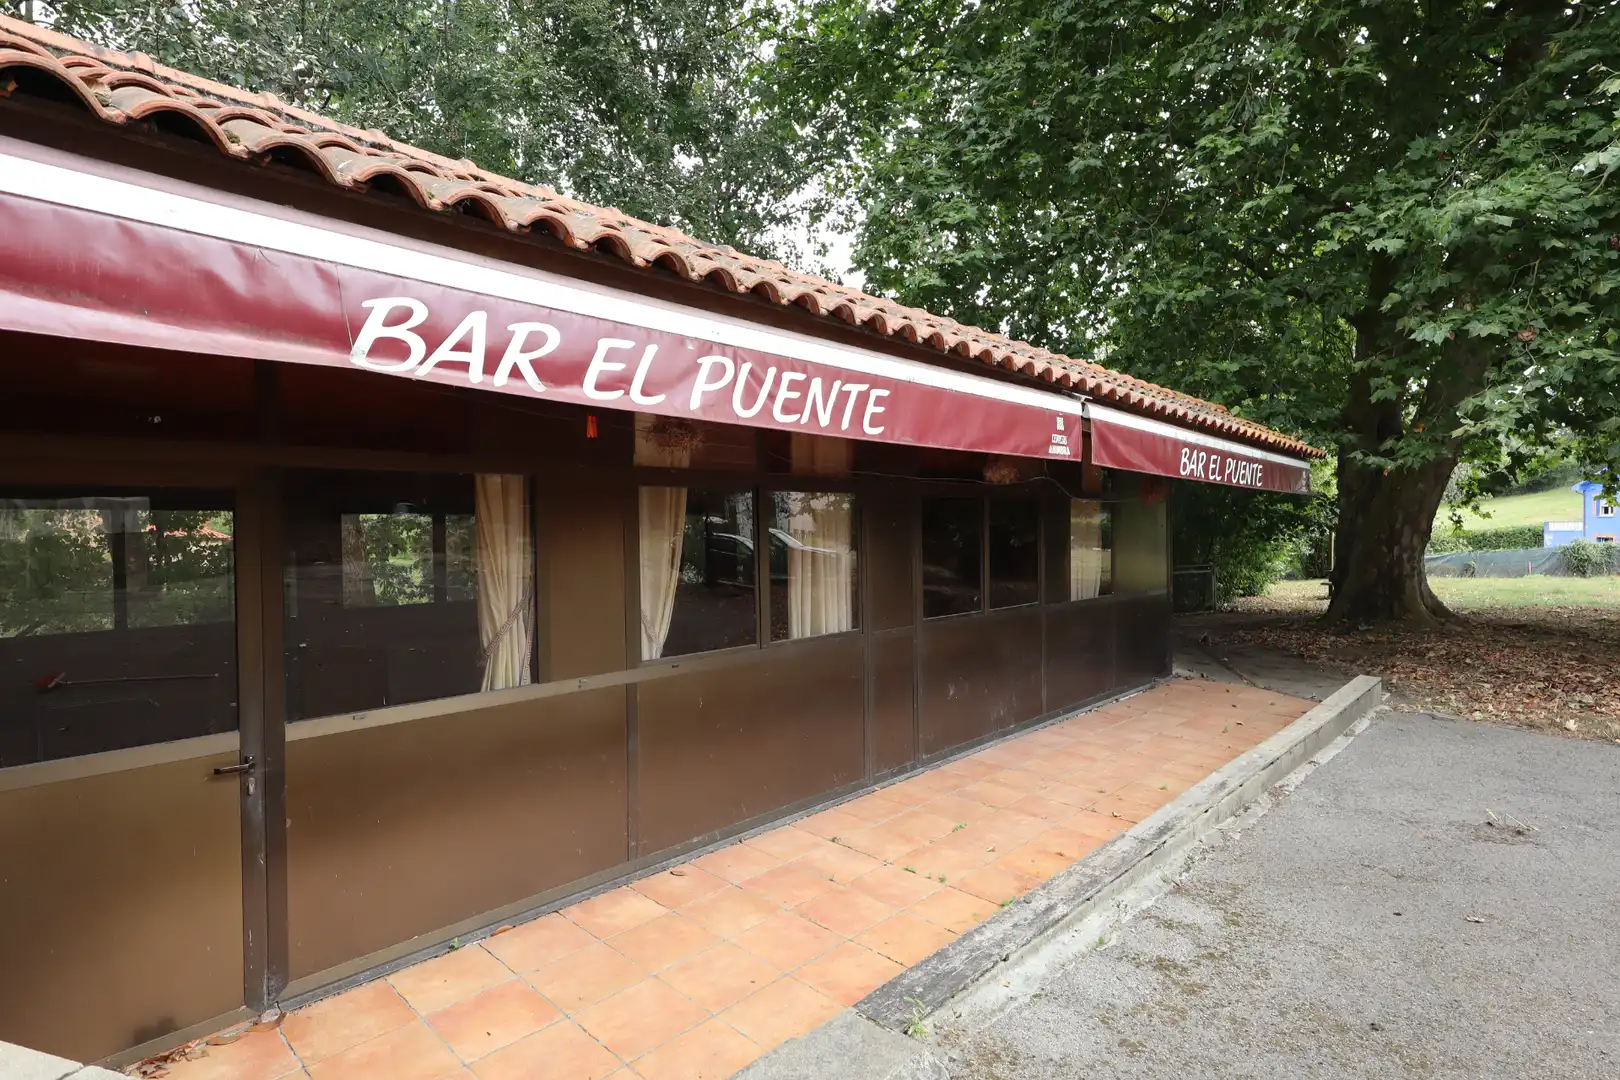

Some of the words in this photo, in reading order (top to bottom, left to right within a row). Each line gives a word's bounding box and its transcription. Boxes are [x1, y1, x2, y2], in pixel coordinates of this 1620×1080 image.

[350, 297, 561, 392] BAR
[583, 337, 667, 405] EL
[689, 355, 891, 435] PUENTE
[1180, 447, 1206, 479] BAR
[1208, 455, 1222, 481] EL
[1224, 458, 1263, 487] PUENTE
